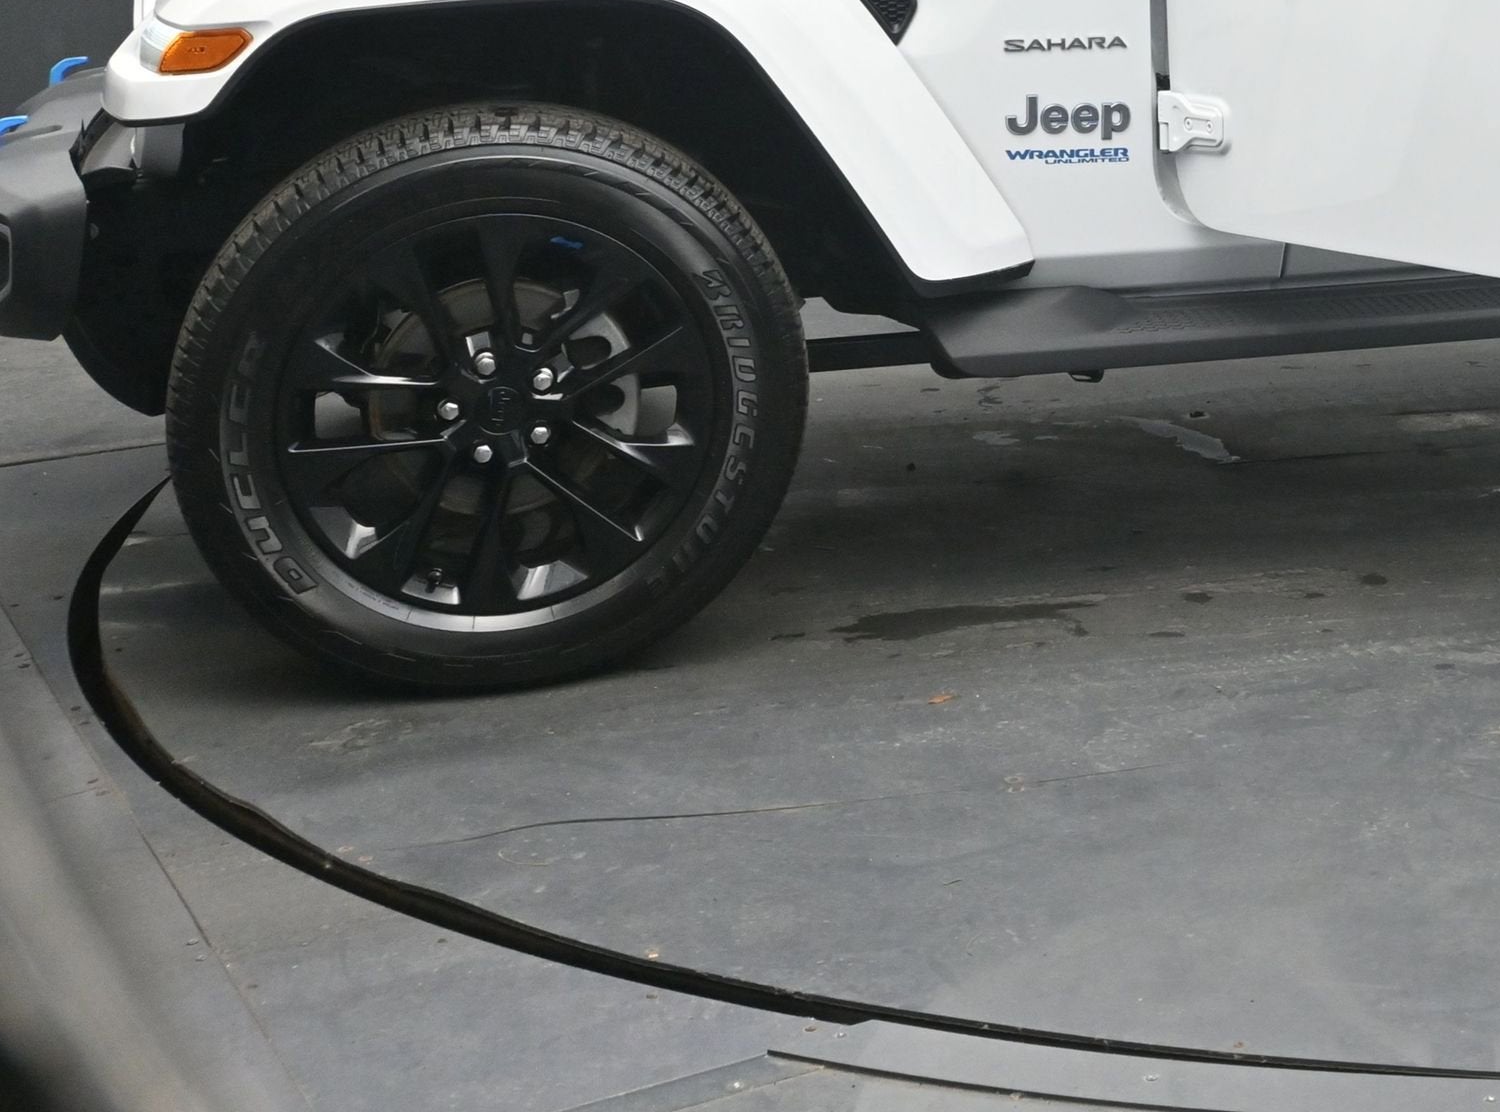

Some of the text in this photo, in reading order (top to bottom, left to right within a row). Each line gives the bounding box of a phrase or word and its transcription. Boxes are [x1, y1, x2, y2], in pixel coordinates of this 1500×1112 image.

[1003, 35, 1128, 53] SAHARA
[1005, 94, 1131, 140] Jeep
[1005, 147, 1129, 160] WRANGLER
[1044, 156, 1130, 165] UNLIMITED
